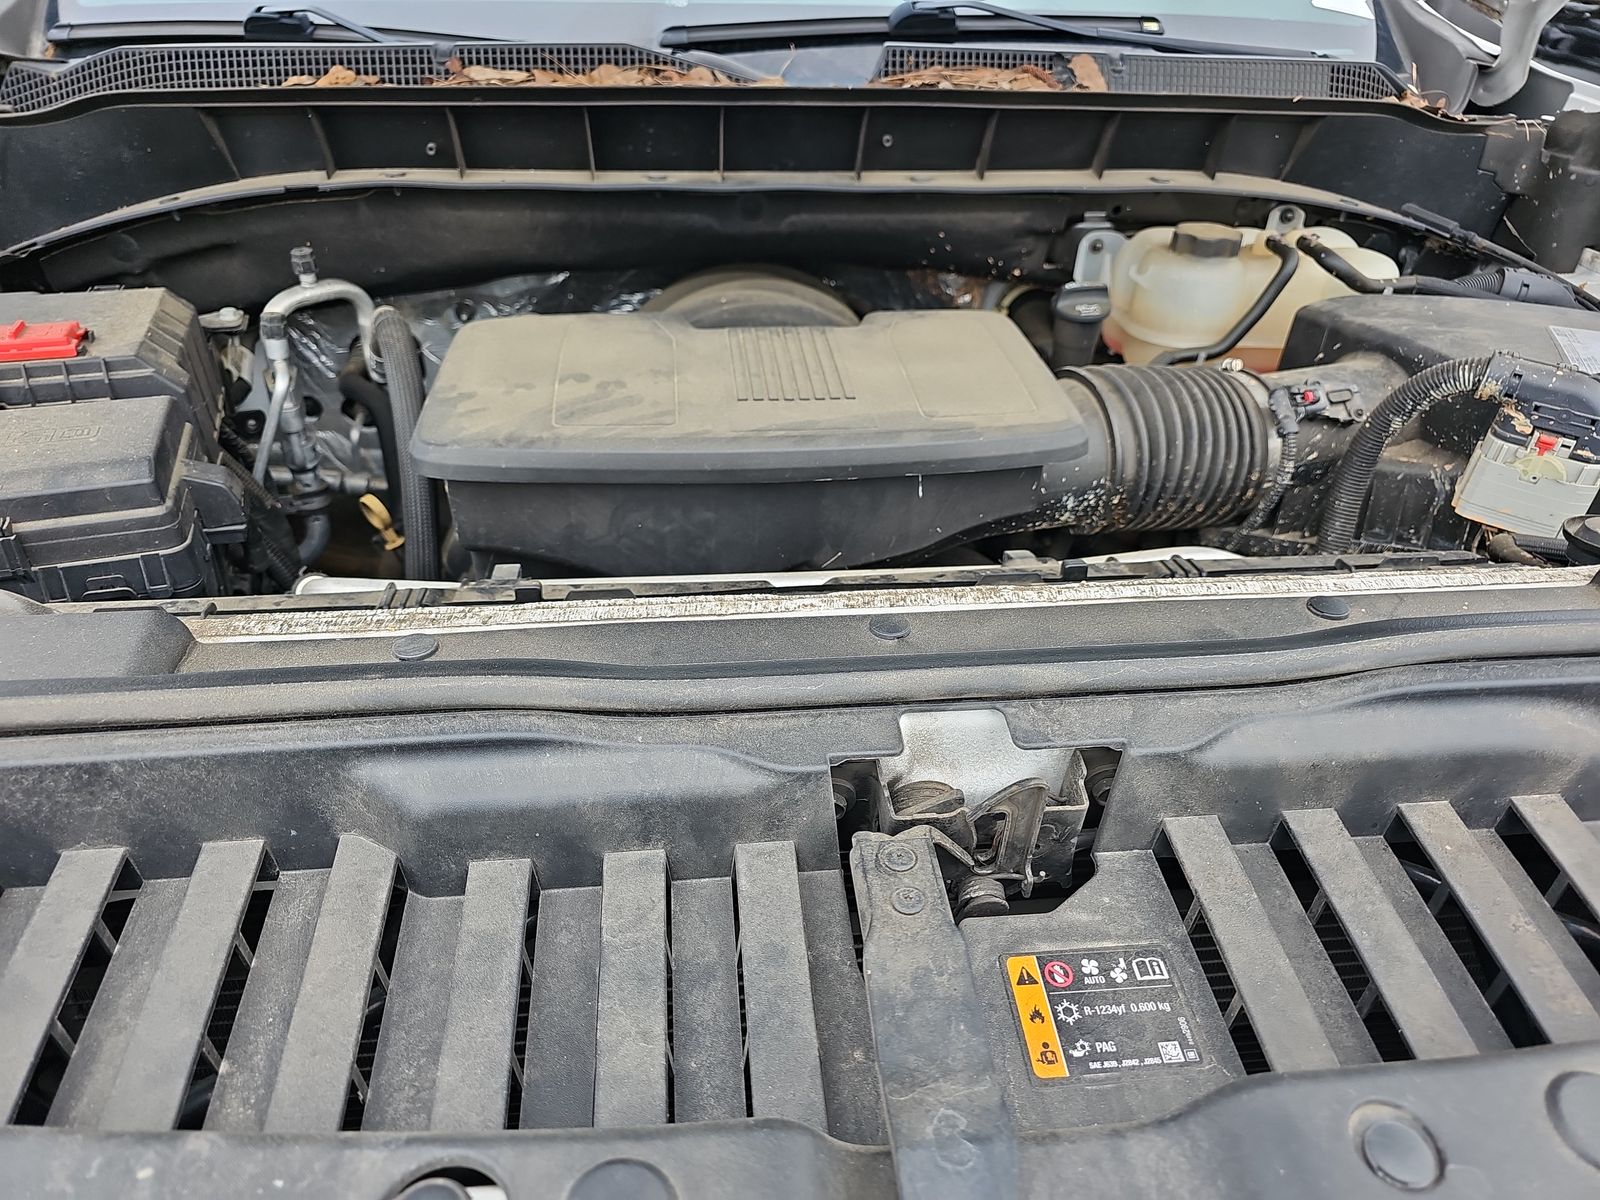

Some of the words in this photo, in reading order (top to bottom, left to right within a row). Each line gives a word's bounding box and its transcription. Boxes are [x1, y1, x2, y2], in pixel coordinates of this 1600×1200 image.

[1084, 975, 1106, 985] AUTO
[1083, 1003, 1127, 1016] R-1234yf
[1130, 1001, 1157, 1013] 0.600
[1157, 1001, 1171, 1012] kg
[1095, 1041, 1117, 1053] PAG
[1088, 1061, 1103, 1069] SAE
